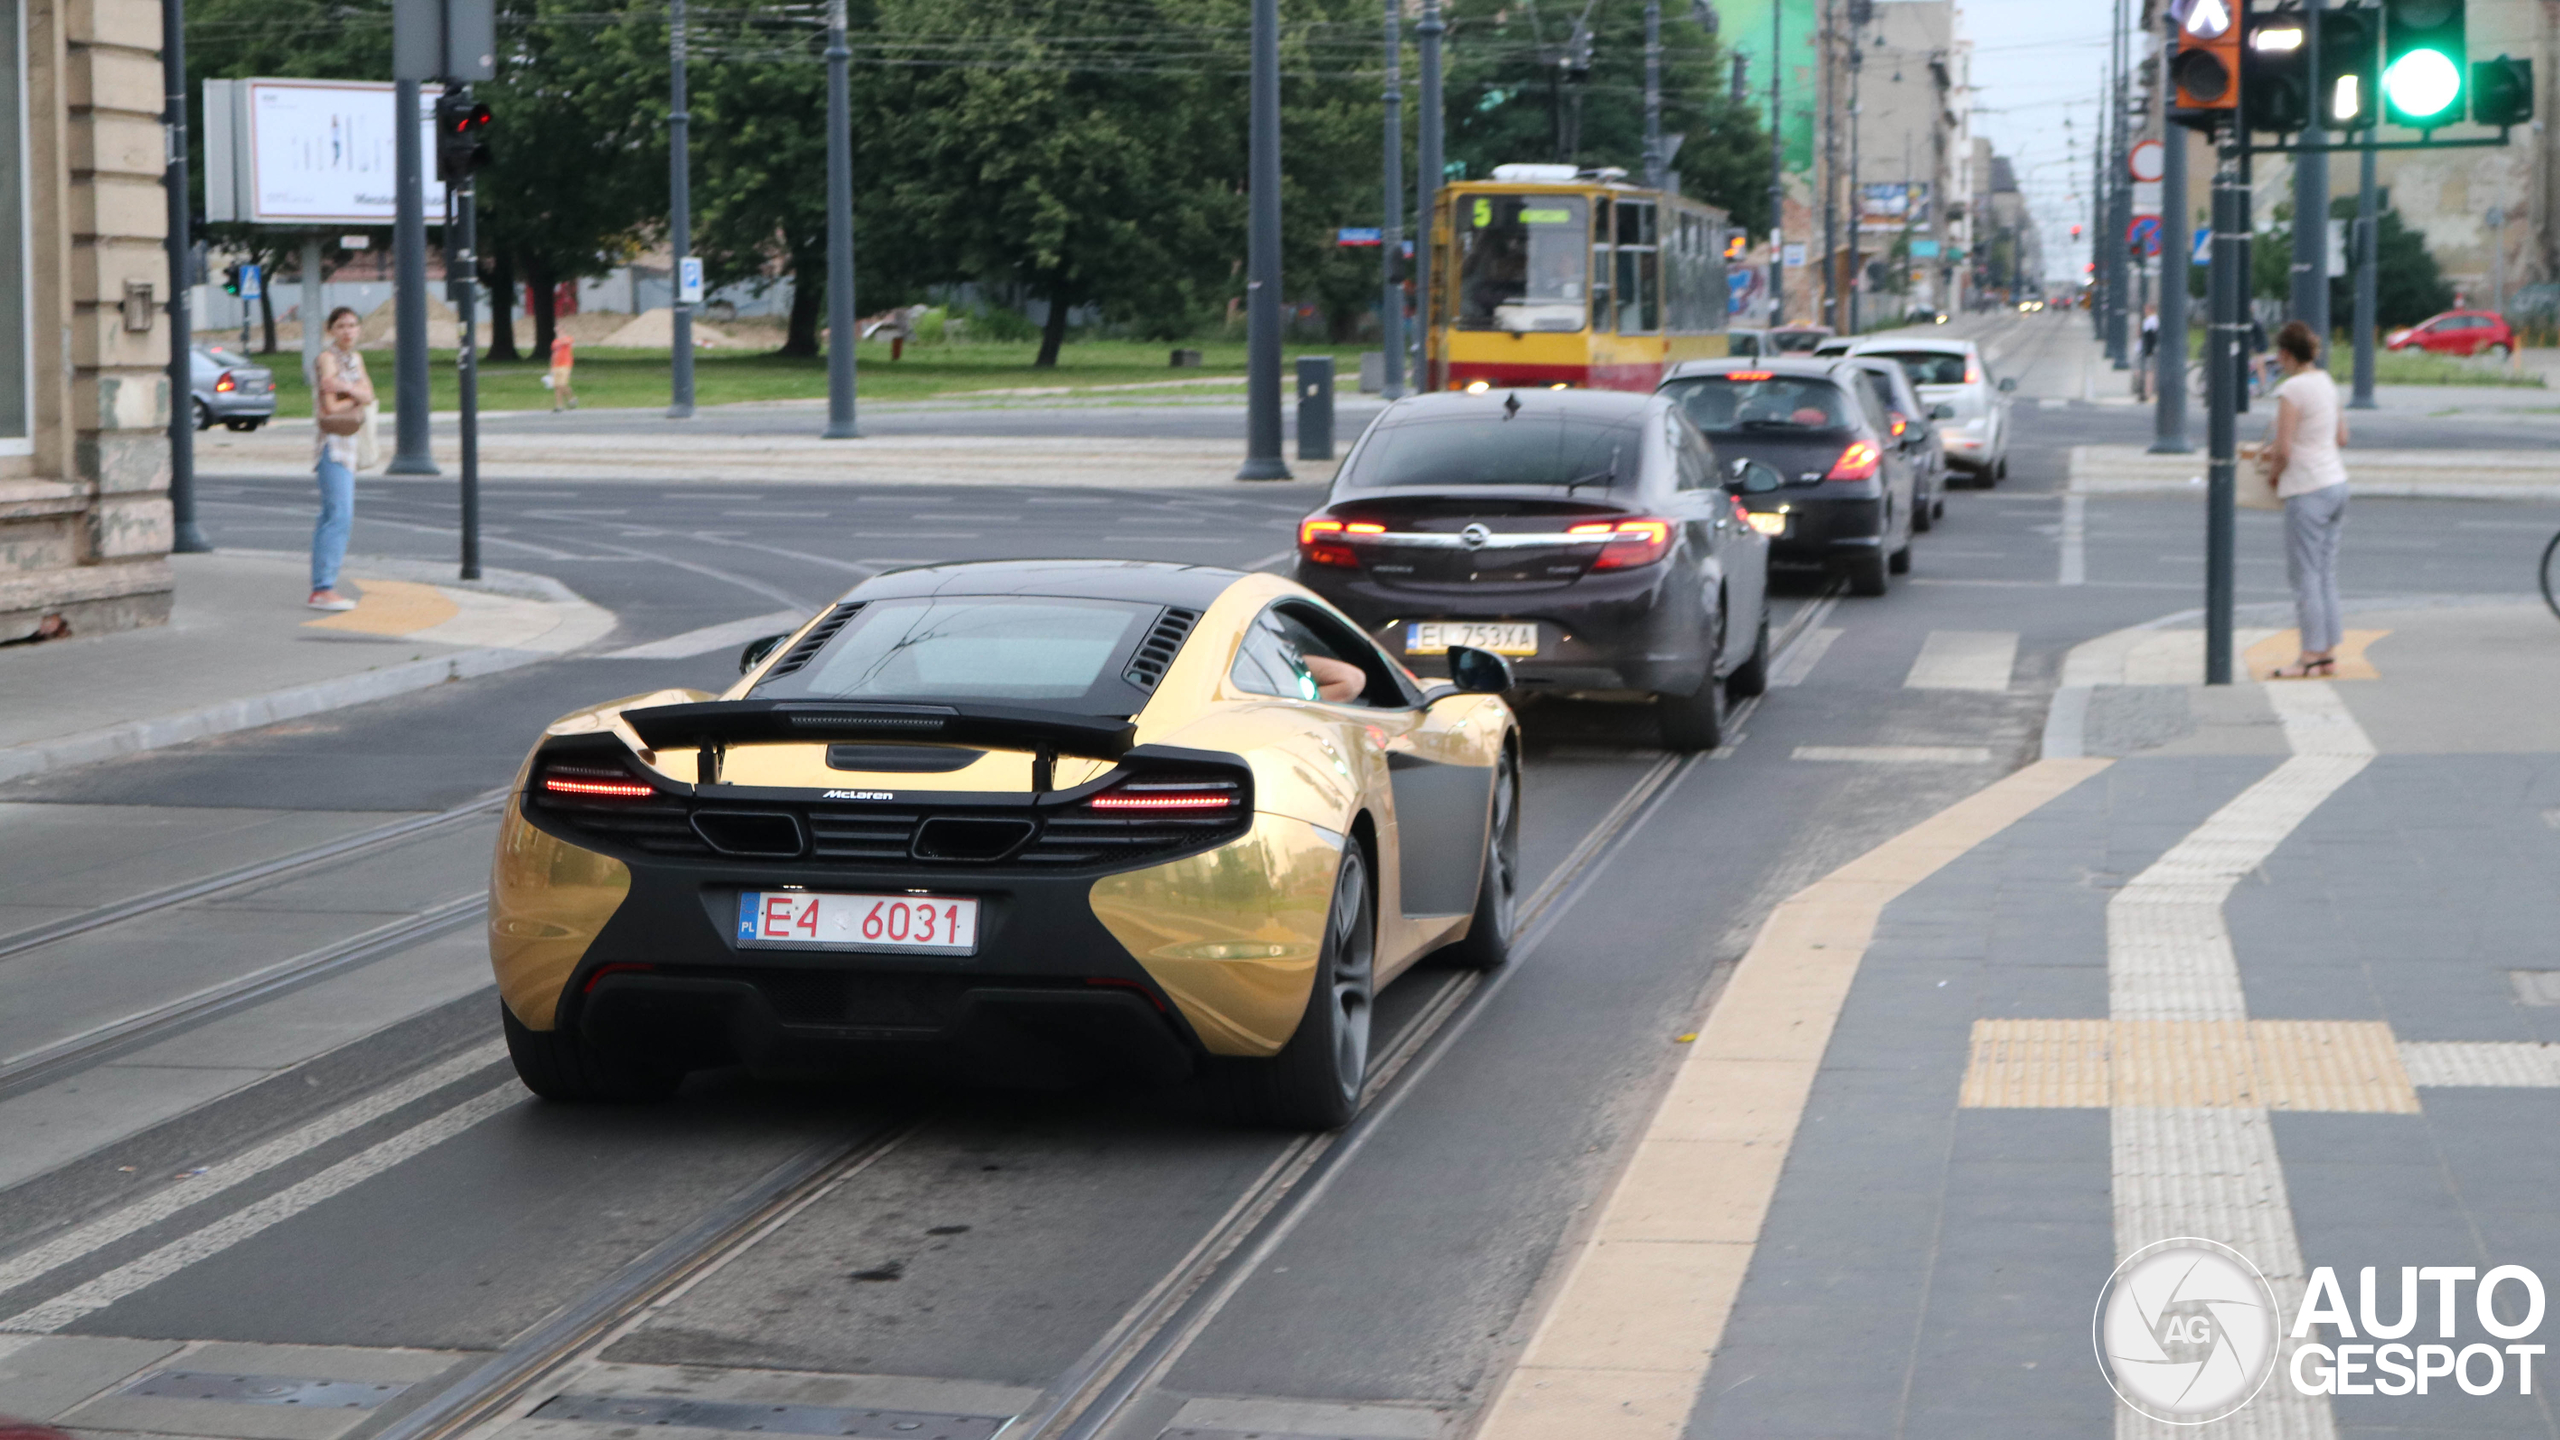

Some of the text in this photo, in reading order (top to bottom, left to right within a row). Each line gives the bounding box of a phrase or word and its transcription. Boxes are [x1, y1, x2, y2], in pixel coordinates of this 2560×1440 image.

[1473, 198, 1492, 228] 5
[1462, 625, 1530, 647] 753XA
[822, 789, 894, 801] McLaren
[741, 921, 755, 933] PL
[764, 897, 959, 944] E4 6031
